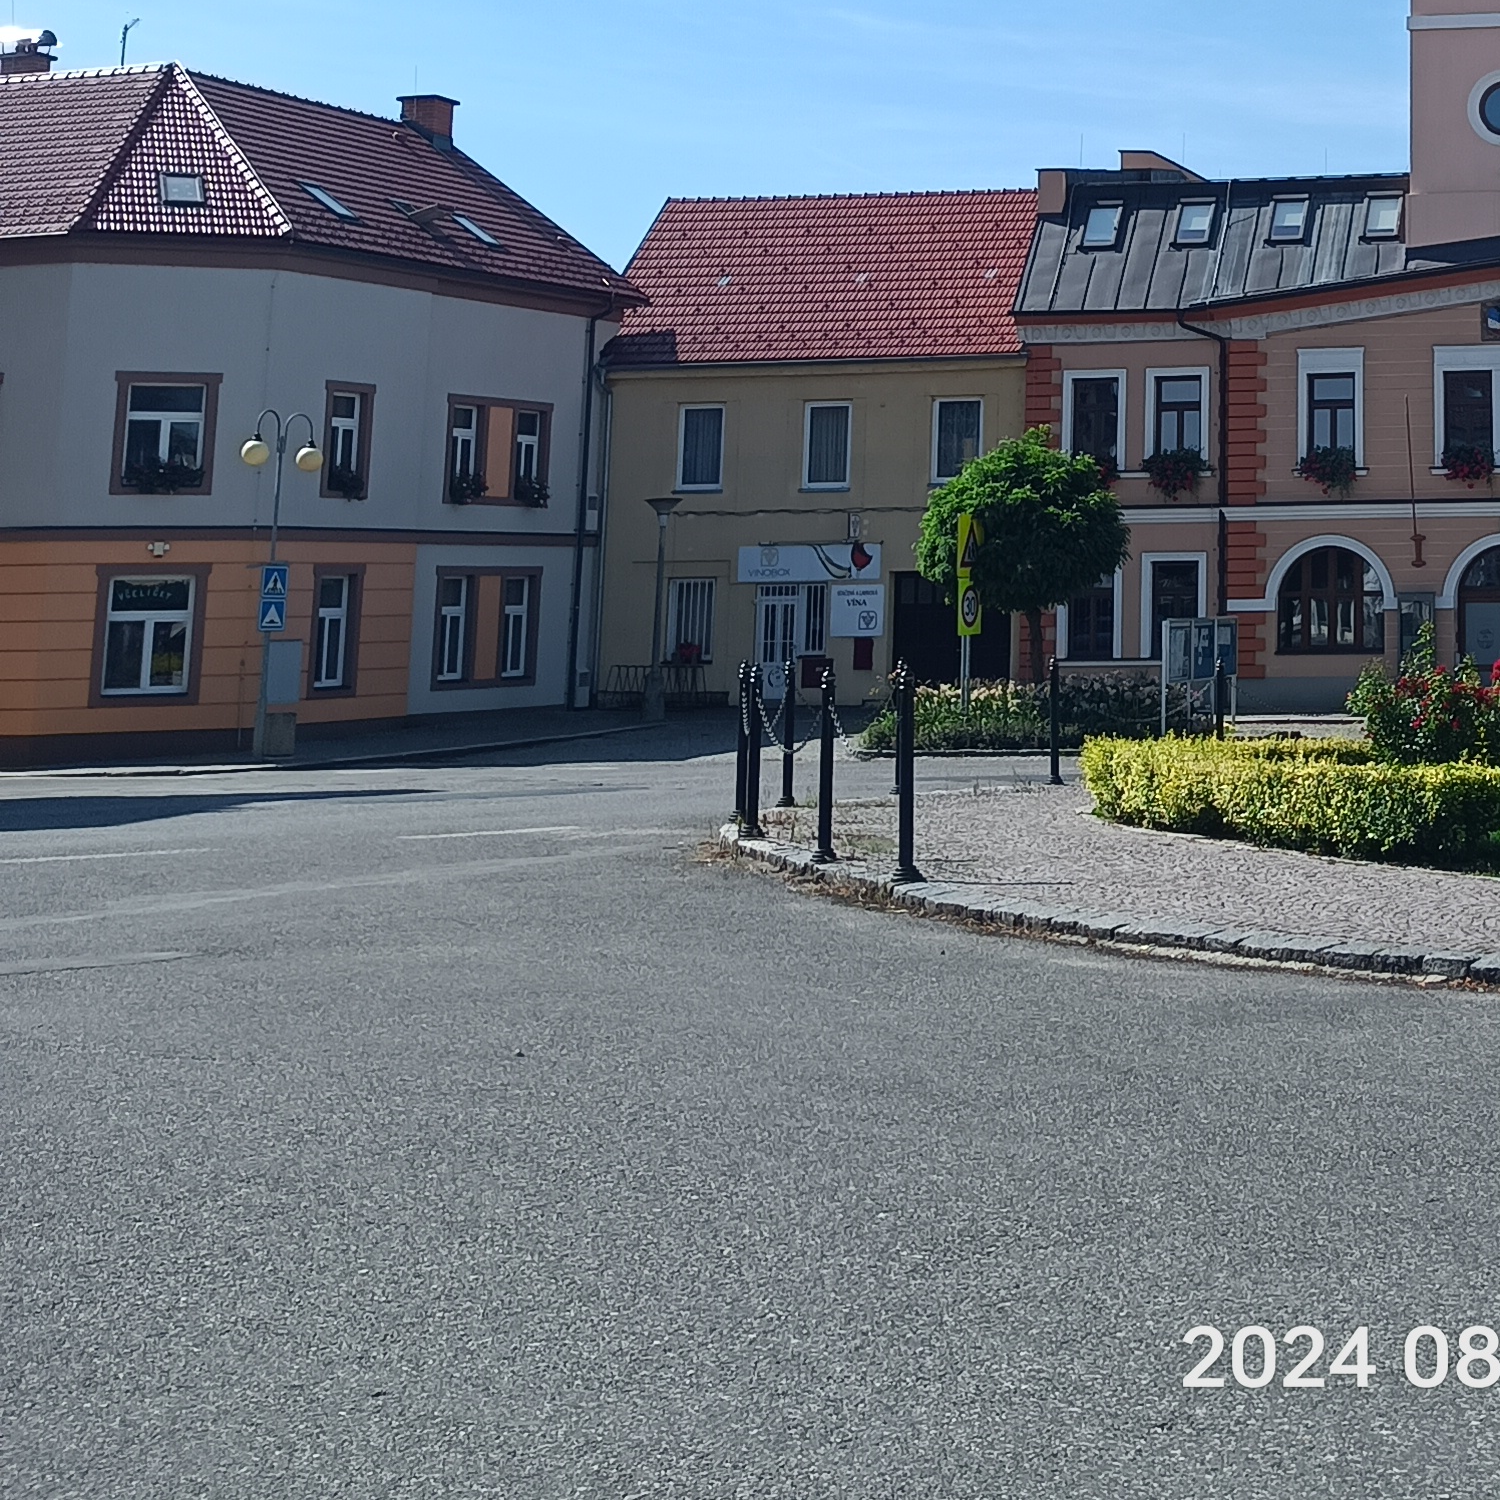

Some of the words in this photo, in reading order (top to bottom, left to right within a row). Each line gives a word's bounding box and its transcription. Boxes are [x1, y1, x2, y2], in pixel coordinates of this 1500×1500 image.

[747, 568, 791, 578] VINOBOX
[846, 598, 867, 607] VÍNA
[965, 596, 975, 617] 30
